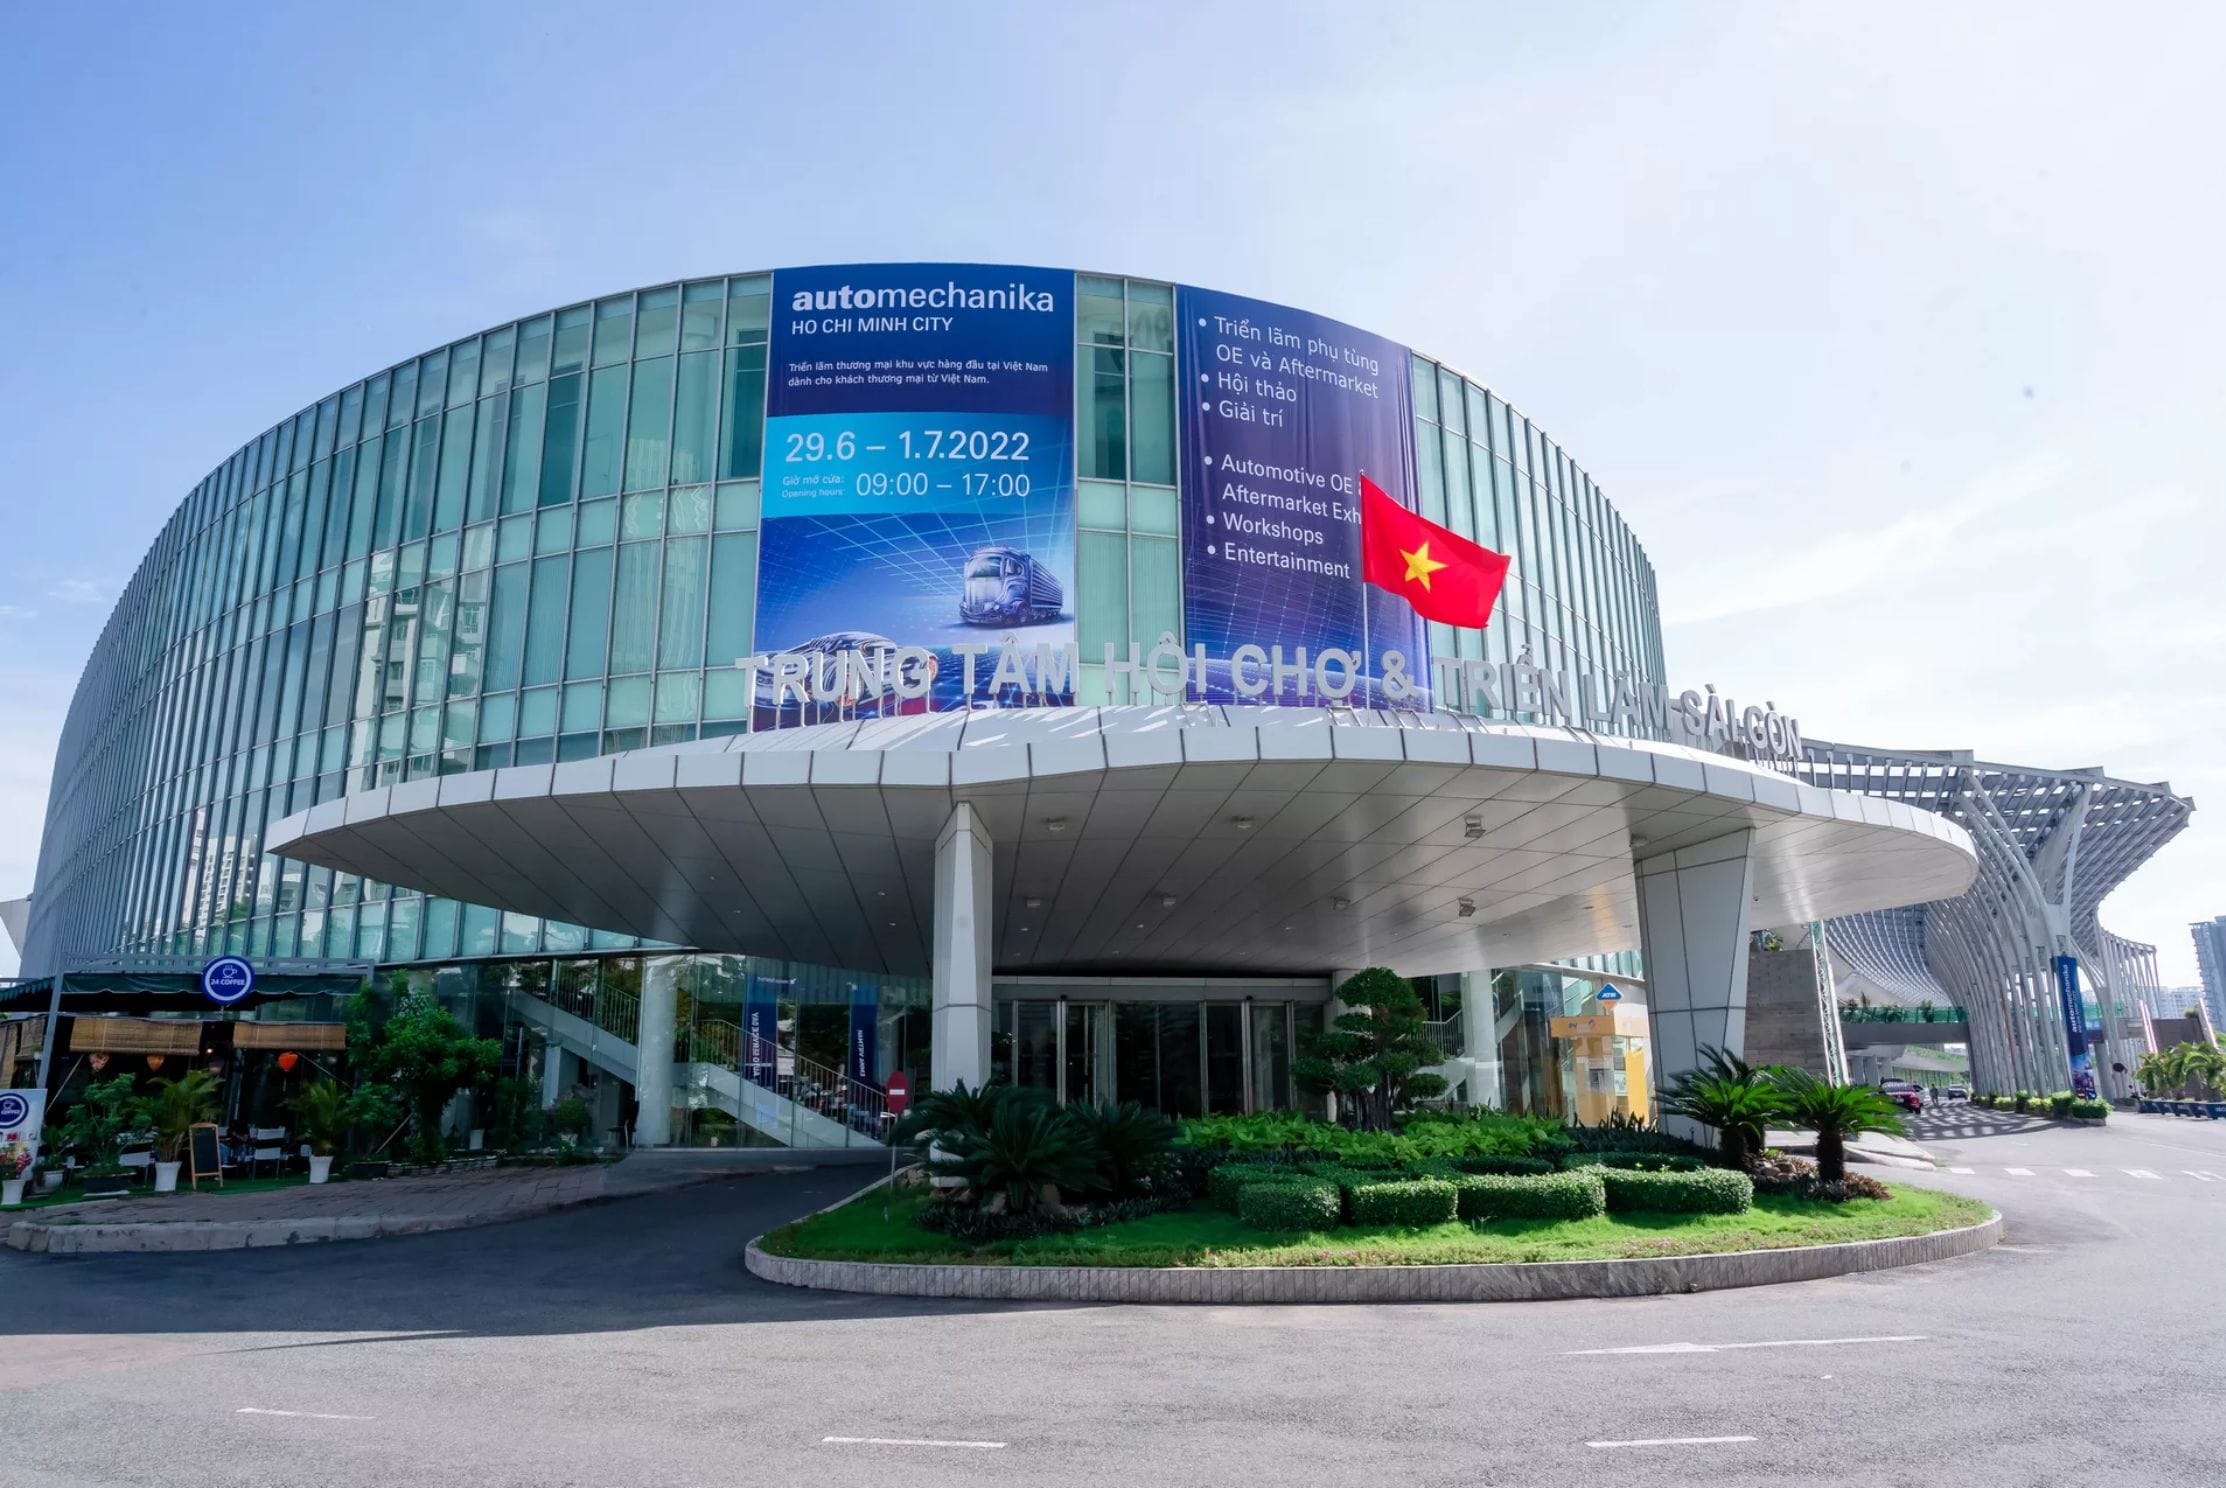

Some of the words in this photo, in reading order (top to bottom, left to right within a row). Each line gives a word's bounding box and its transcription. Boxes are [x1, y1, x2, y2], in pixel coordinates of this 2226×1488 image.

[791, 281, 1054, 313] automechanika
[791, 319, 817, 335] HO
[822, 318, 853, 334] CHI
[857, 317, 907, 333] MINH
[912, 316, 954, 332] CITY
[1213, 315, 1261, 342] Triển
[1267, 326, 1301, 350] lãm
[1307, 337, 1339, 363] phụ
[1343, 347, 1379, 377] tùng
[788, 375, 813, 387] dành
[814, 375, 833, 386] cho
[834, 374, 865, 385] khách
[867, 373, 903, 386] thương
[905, 373, 925, 385] mại
[926, 372, 940, 384] từ
[940, 373, 961, 385] Việt
[963, 373, 991, 385] Nam.
[815, 361, 834, 371] lãm
[836, 360, 872, 372] thương
[874, 359, 893, 371] mại
[895, 358, 914, 369] khu
[916, 359, 935, 371] vực
[938, 358, 963, 371] hàng
[965, 358, 985, 370] đầu
[986, 360, 1001, 372] tại
[1002, 360, 1023, 373] Việt
[1025, 362, 1048, 373] Nam
[1216, 343, 1244, 365] OE
[1249, 350, 1272, 371] và
[1278, 356, 1380, 399] Aftermarket
[1218, 370, 1249, 396] Hội
[1255, 378, 1297, 402] thảo
[1219, 399, 1256, 423] Giải
[1262, 407, 1284, 428] trí
[785, 430, 857, 463] 29.6
[899, 429, 1031, 462] 1.7.2022
[855, 471, 929, 497] 09:00
[961, 472, 1031, 498] 17:00
[1220, 453, 1326, 489] Automotive
[1330, 472, 1354, 495] OE
[1222, 482, 1329, 518] Aftermarket
[1332, 501, 1362, 525] Exh
[1223, 511, 1325, 546] Workshops
[1224, 541, 1351, 579] Entertainment
[734, 647, 932, 707] TRUNG
[953, 631, 1080, 695] TÂM
[1380, 649, 1416, 701] &
[1431, 642, 1572, 720] TRIỂN
[1583, 670, 1672, 731] LÃM
[1680, 683, 1740, 741] SÀI
[1743, 700, 1804, 761] GÒN
